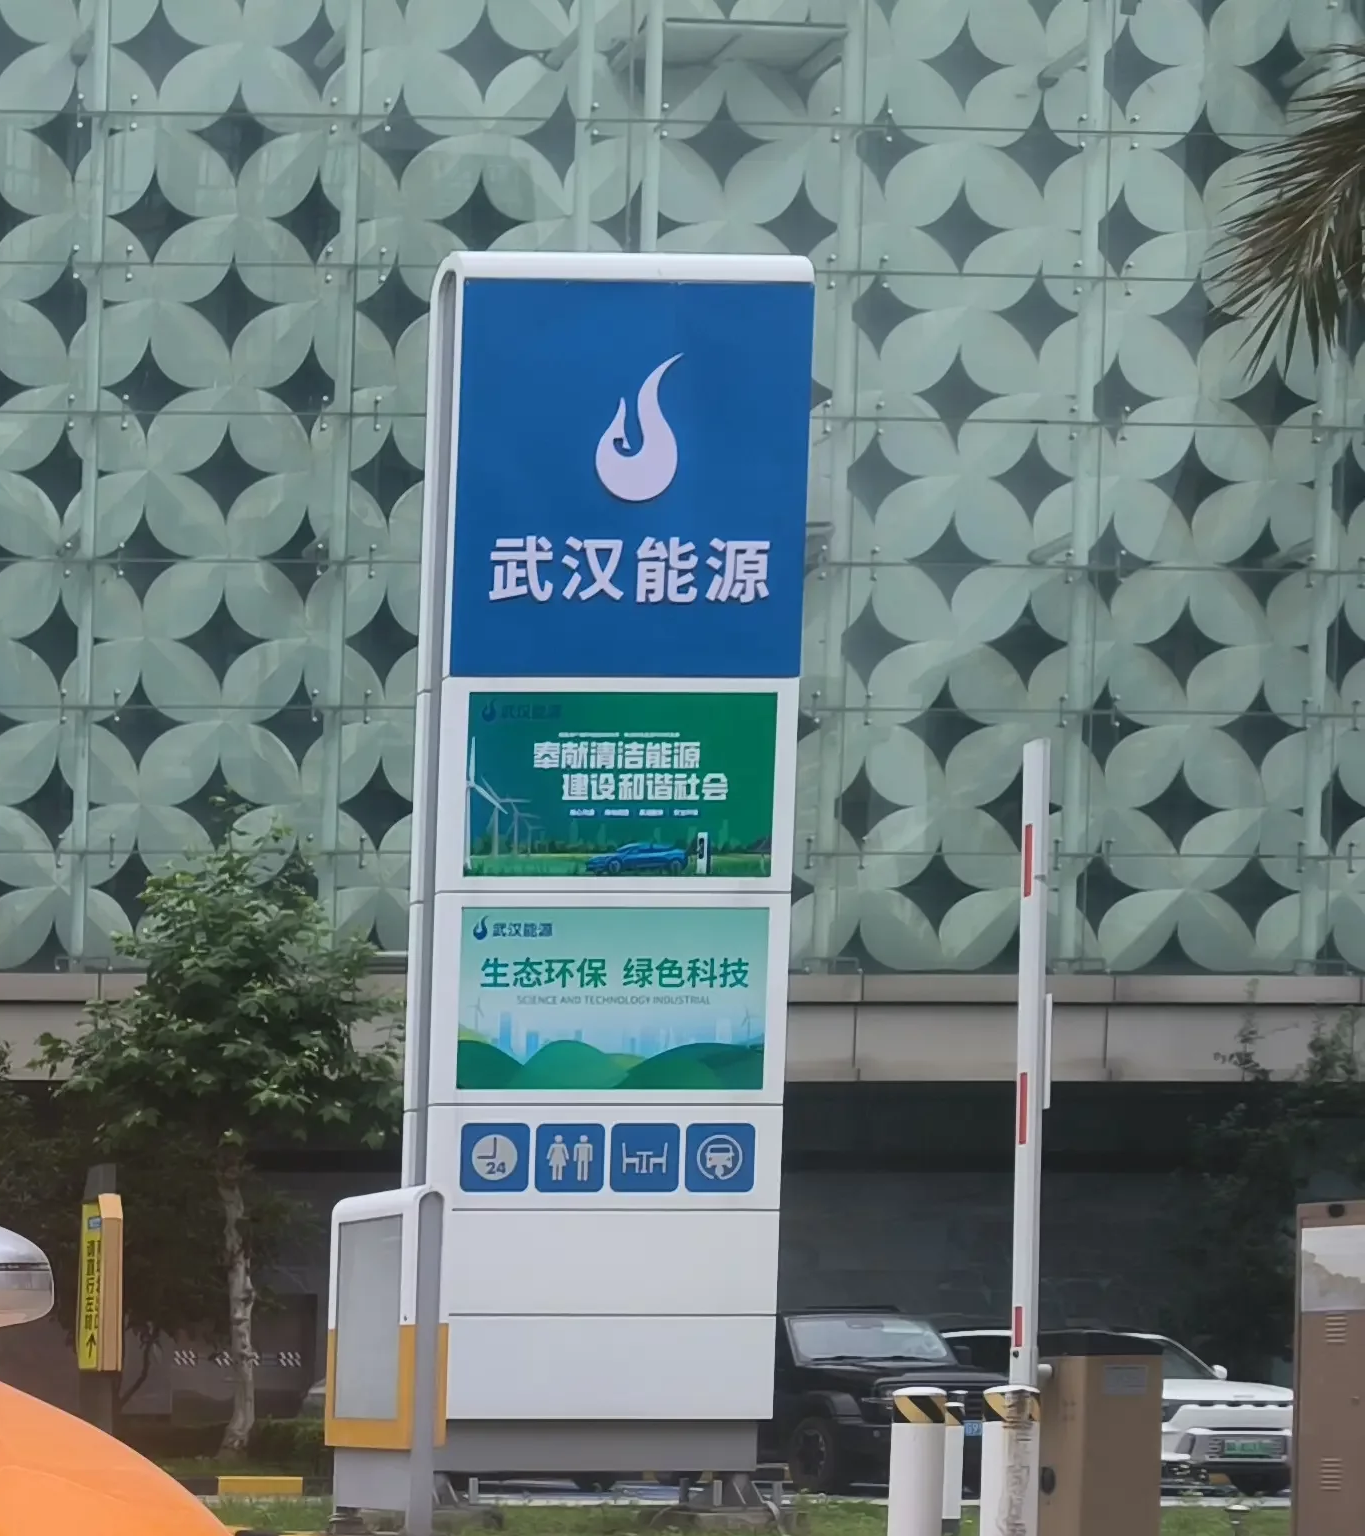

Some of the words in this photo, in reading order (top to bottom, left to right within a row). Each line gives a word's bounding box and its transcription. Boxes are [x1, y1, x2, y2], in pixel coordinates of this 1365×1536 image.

[488, 535, 771, 604] 武汉能源
[533, 741, 701, 769] 奉献清洁能源
[562, 773, 729, 801] 建设和谐社会
[492, 922, 553, 938] 武汉能源
[480, 957, 607, 989] 生态环保
[622, 957, 750, 989] 绿色科技
[485, 1161, 507, 1175] 24
